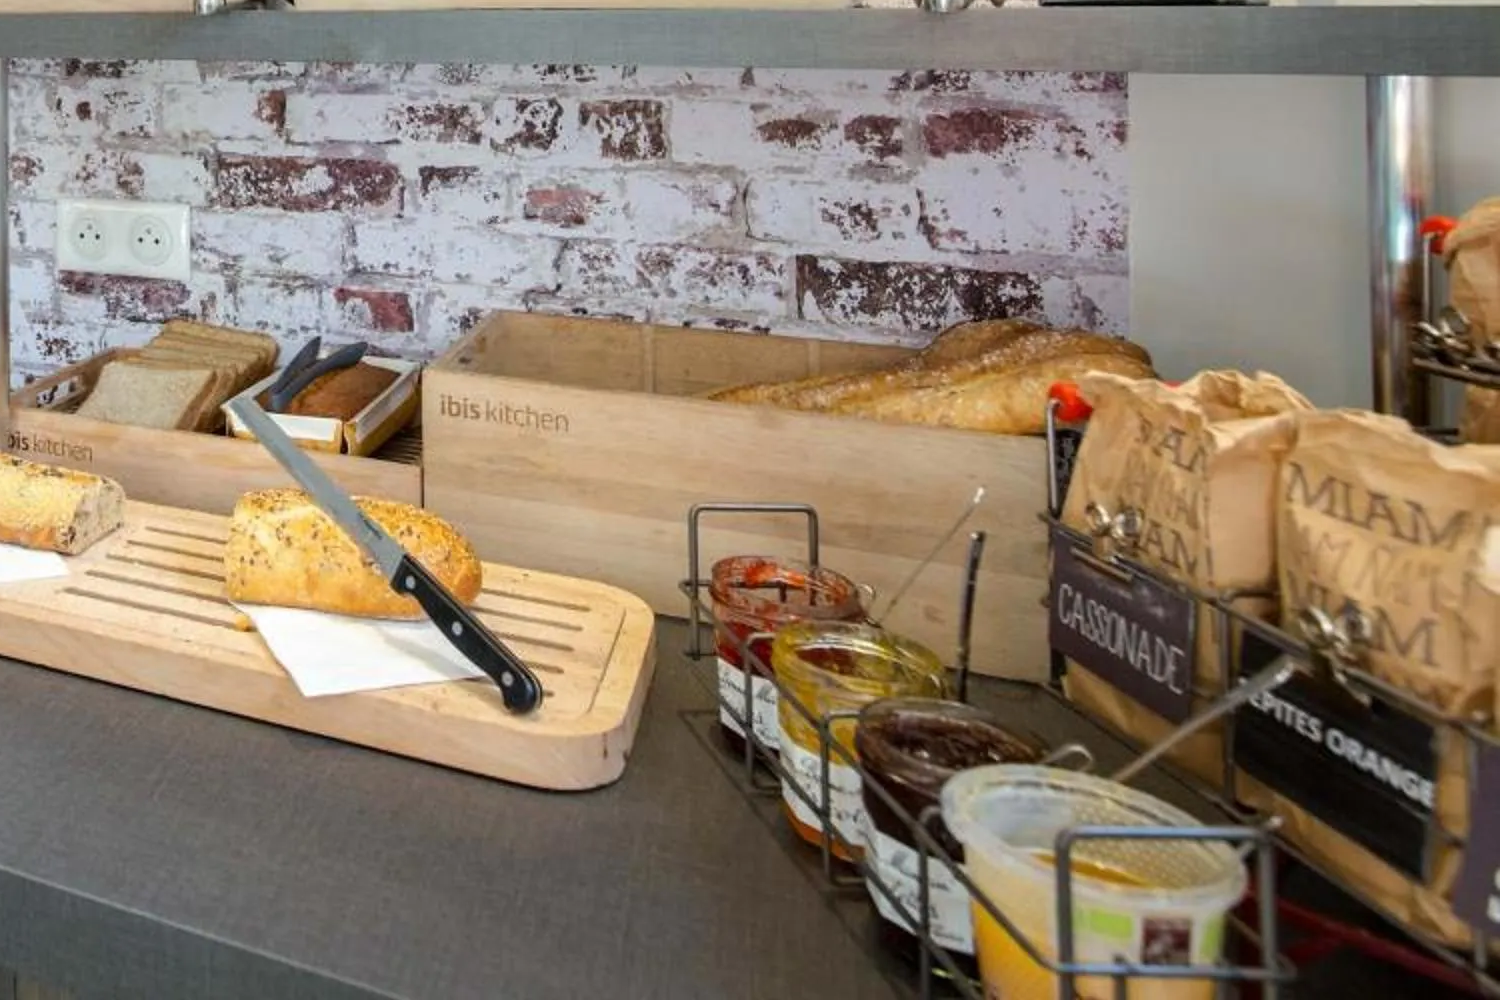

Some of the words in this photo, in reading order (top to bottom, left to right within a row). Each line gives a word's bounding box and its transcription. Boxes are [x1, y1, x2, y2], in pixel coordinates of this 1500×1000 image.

[440, 394, 481, 420] ibis
[485, 400, 570, 432] kitchen
[1057, 583, 1186, 696] CASSONADE
